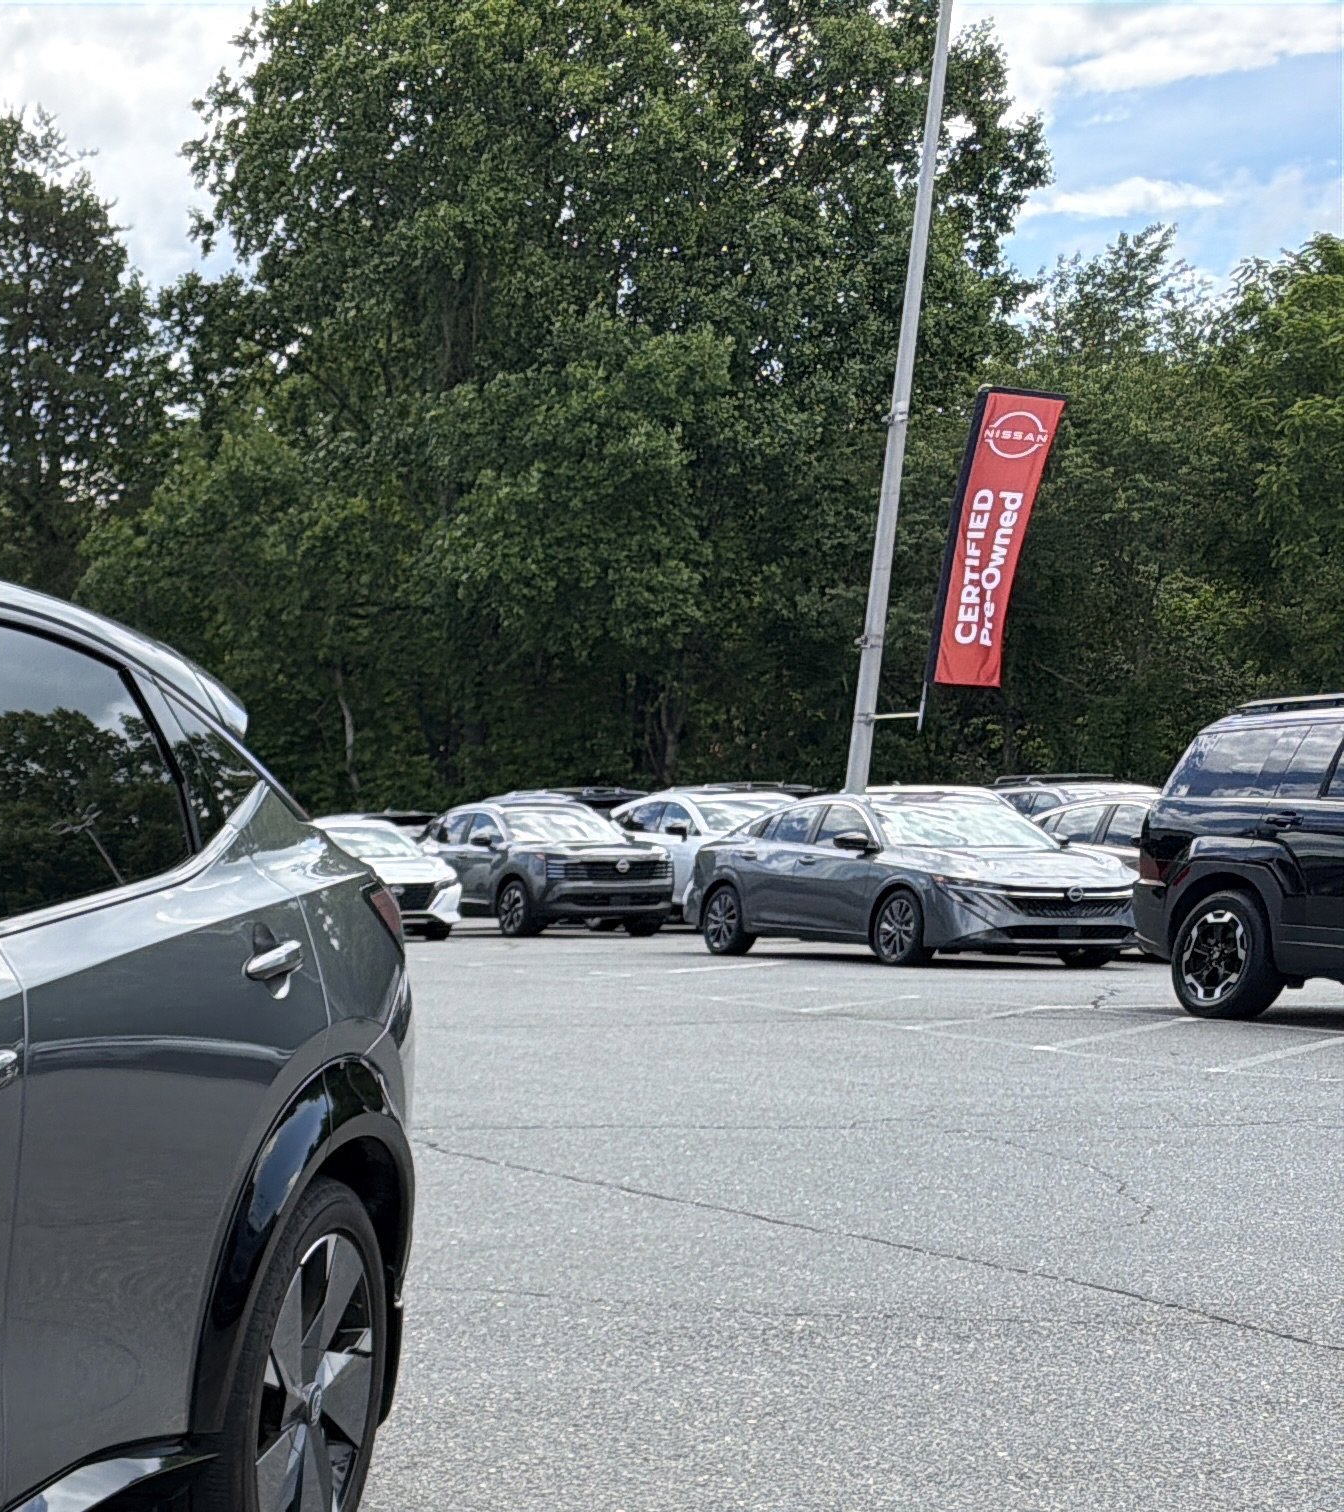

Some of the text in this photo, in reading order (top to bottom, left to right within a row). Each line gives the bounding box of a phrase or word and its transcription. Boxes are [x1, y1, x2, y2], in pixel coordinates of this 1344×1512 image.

[984, 428, 1048, 443] NISSAN
[954, 488, 995, 645] CERTIFIED
[979, 491, 1023, 647] Pre-Owned
